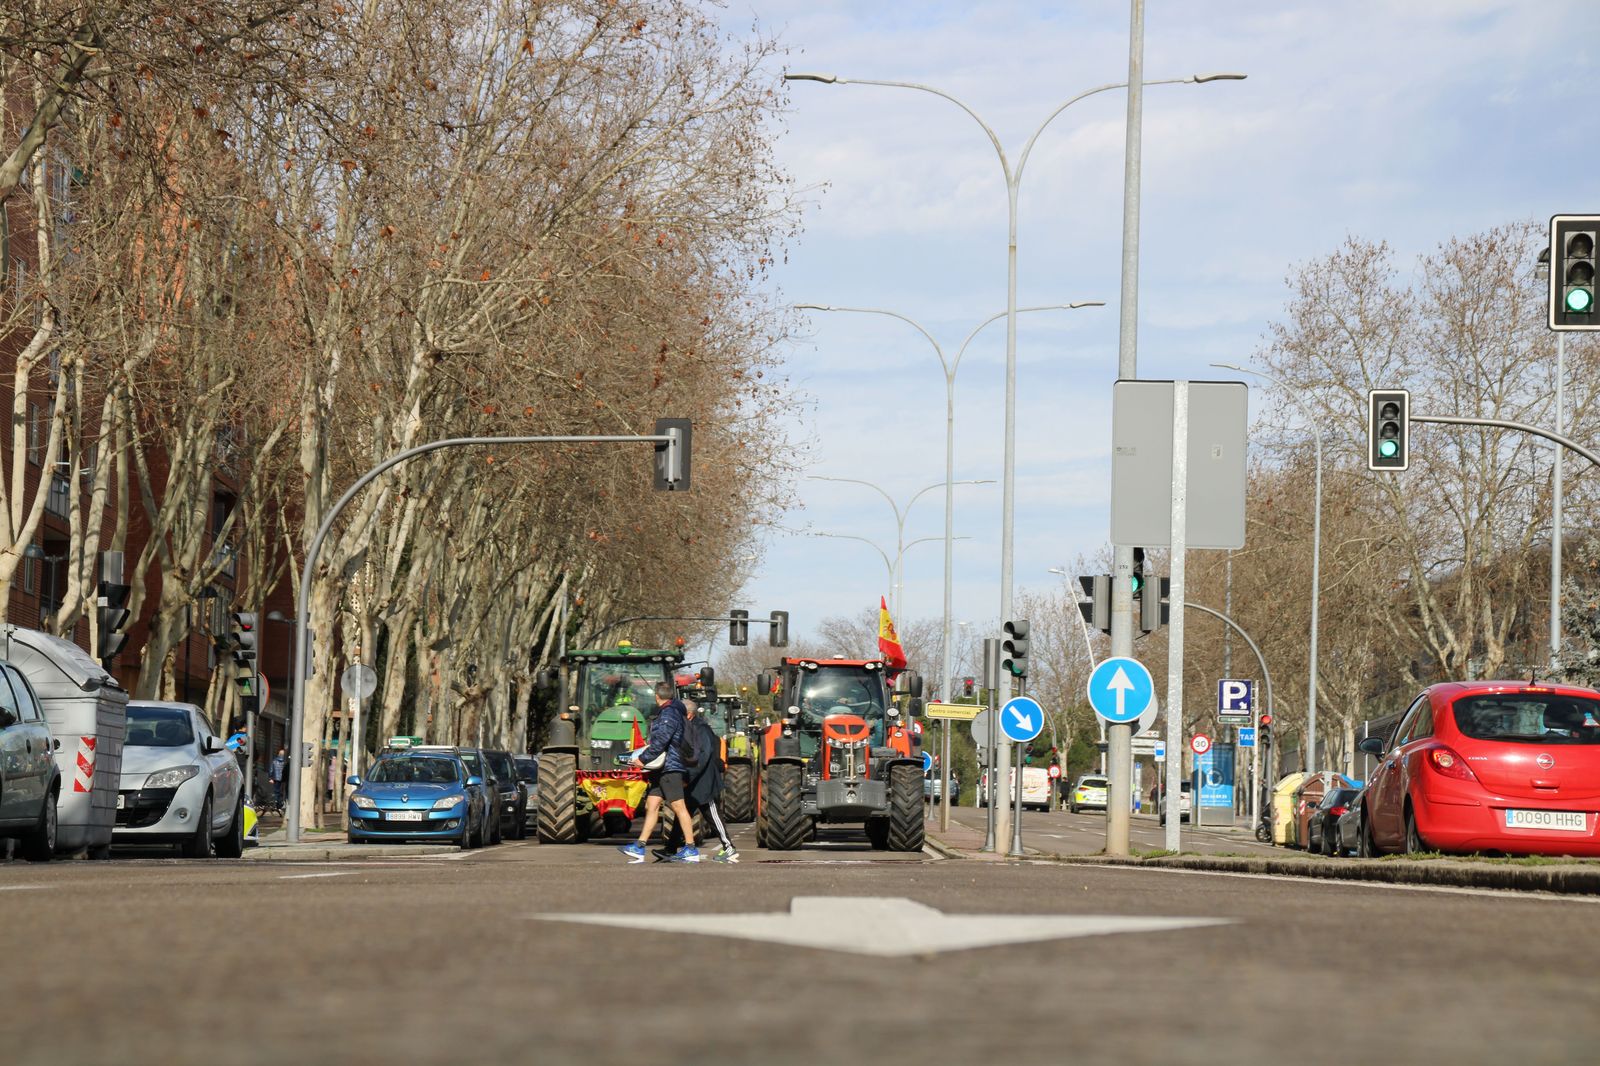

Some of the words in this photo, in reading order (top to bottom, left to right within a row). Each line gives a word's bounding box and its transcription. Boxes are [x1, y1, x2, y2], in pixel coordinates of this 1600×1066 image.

[1223, 681, 1247, 709] P
[1516, 811, 1552, 825] 0090
[1556, 813, 1582, 826] HHG
